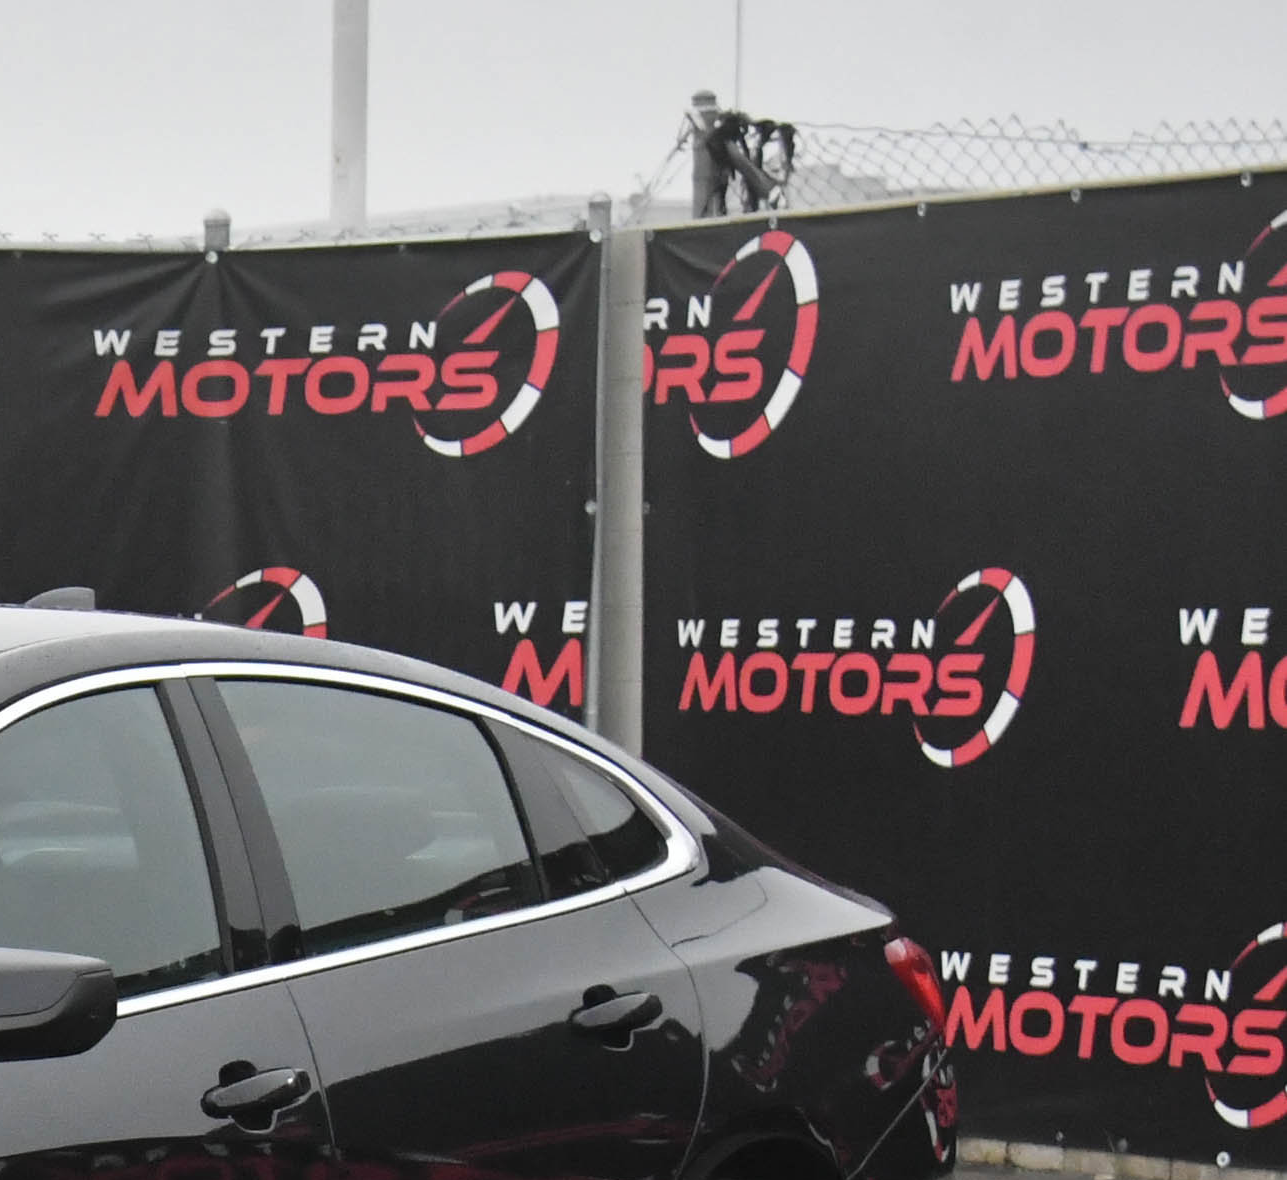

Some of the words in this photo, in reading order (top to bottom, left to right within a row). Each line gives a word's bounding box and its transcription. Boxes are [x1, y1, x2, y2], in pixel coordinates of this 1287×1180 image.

[950, 260, 1245, 314] WESTERN
[93, 321, 437, 357] WESTERN
[951, 295, 1287, 382] MOTORS
[96, 351, 500, 418] MOTORS
[677, 618, 935, 649] WESTERN
[679, 651, 985, 717] MOTORS
[940, 950, 1231, 1002] WESTERN
[944, 986, 1287, 1076] MOTORS
